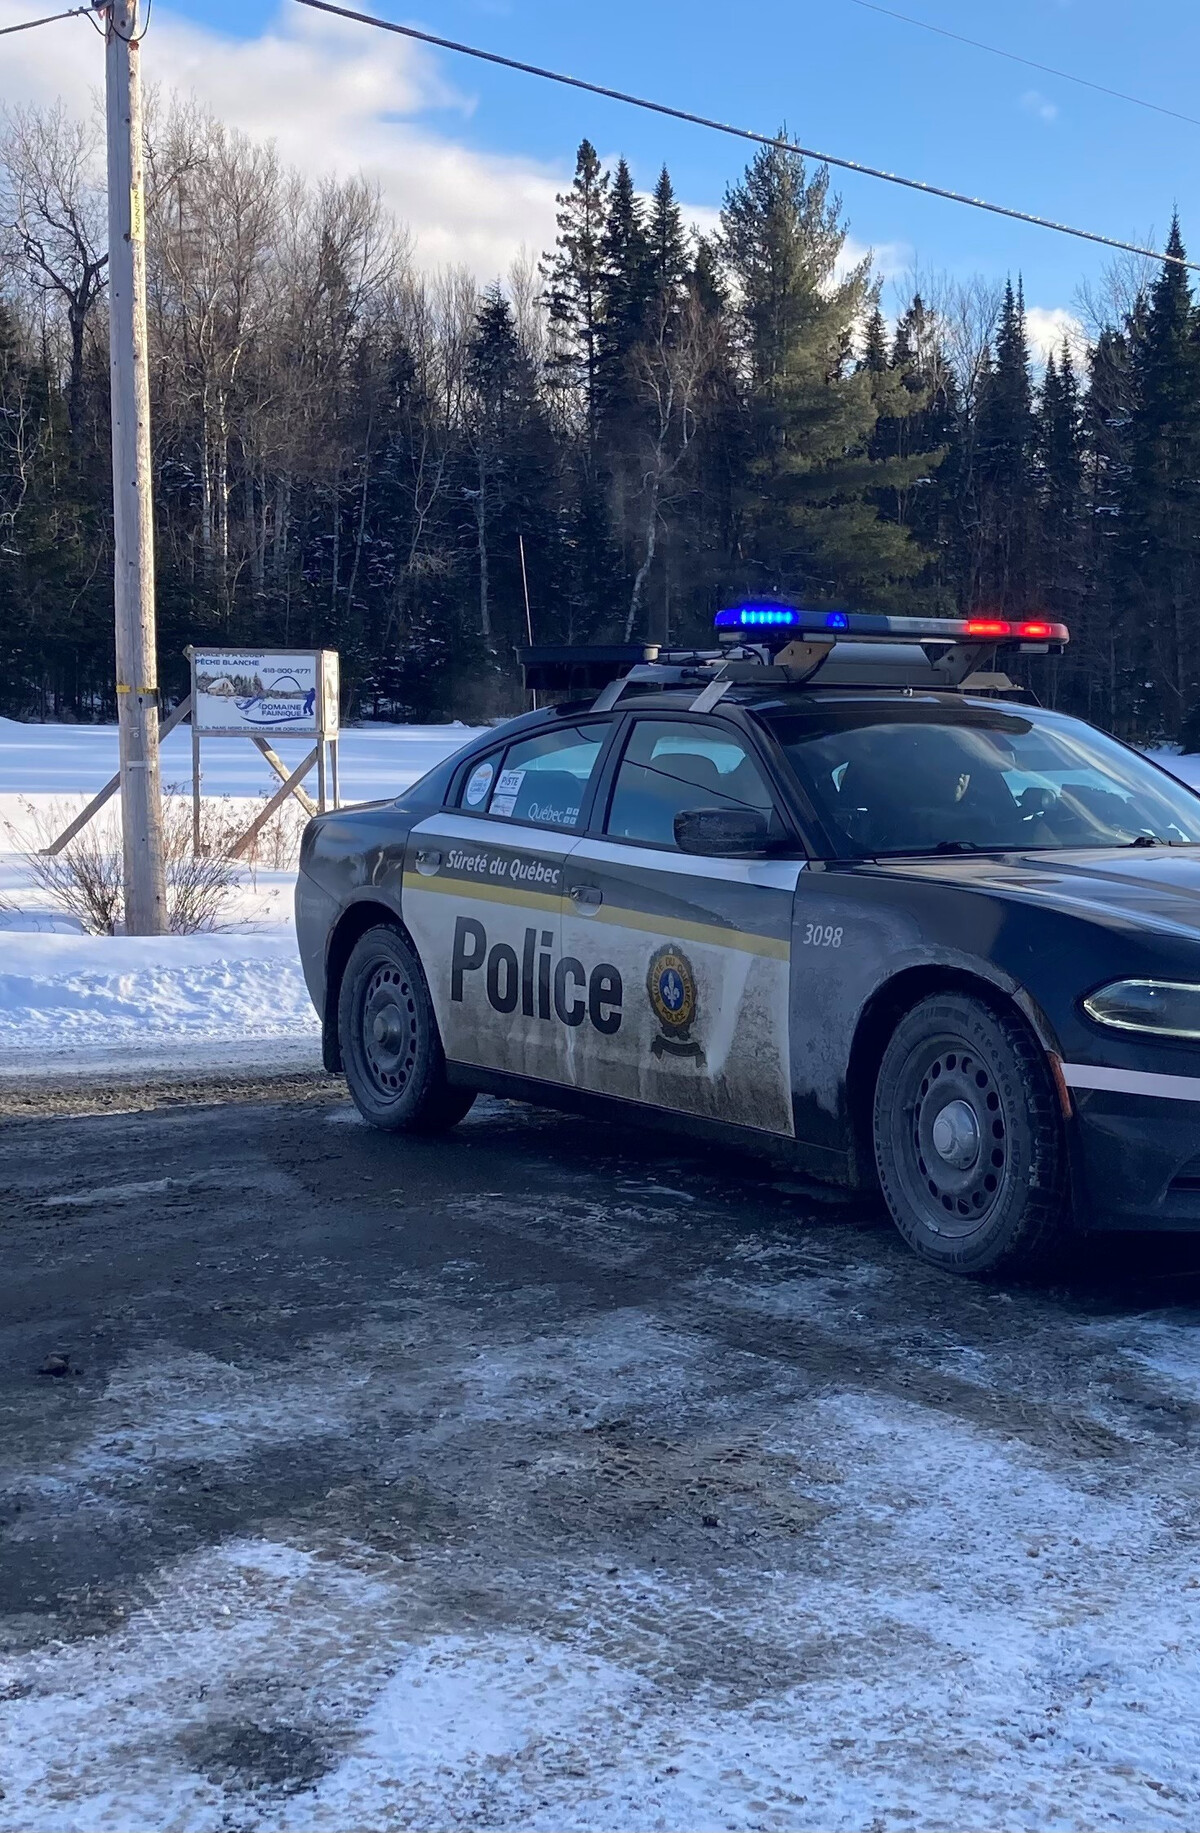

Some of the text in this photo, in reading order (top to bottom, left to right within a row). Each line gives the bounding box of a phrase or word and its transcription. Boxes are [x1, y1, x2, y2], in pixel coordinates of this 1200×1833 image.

[528, 803, 564, 823] Québec
[446, 850, 561, 884] Sûreté du Québec
[802, 923, 844, 948] 3098
[450, 915, 624, 1036] Police
